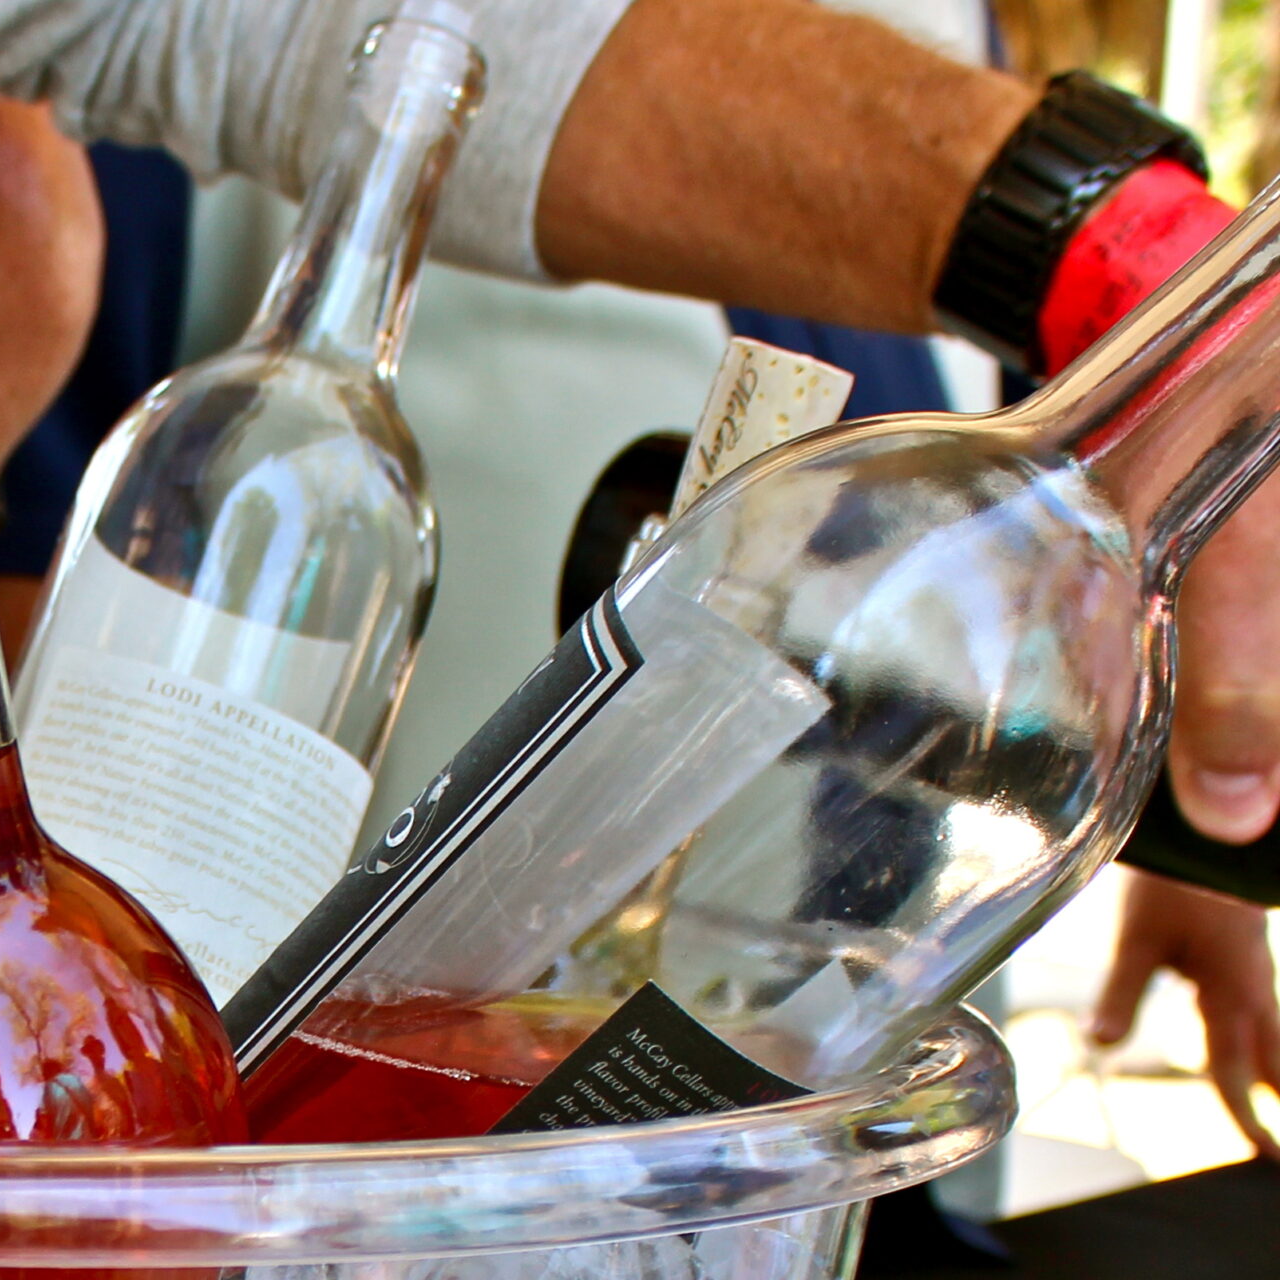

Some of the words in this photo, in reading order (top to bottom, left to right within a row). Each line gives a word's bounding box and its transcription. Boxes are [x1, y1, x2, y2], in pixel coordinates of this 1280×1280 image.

[145, 677, 202, 708] LODI
[209, 700, 335, 771] APPELLATION
[586, 1059, 630, 1095] flavor
[624, 1093, 670, 1121] profil
[608, 1043, 622, 1059] is
[620, 1054, 661, 1090] hands
[658, 1086, 679, 1102] on
[675, 1097, 694, 1113] in
[625, 1027, 673, 1069] McCay
[671, 1063, 714, 1098] Cellars
[555, 1093, 580, 1115] the
